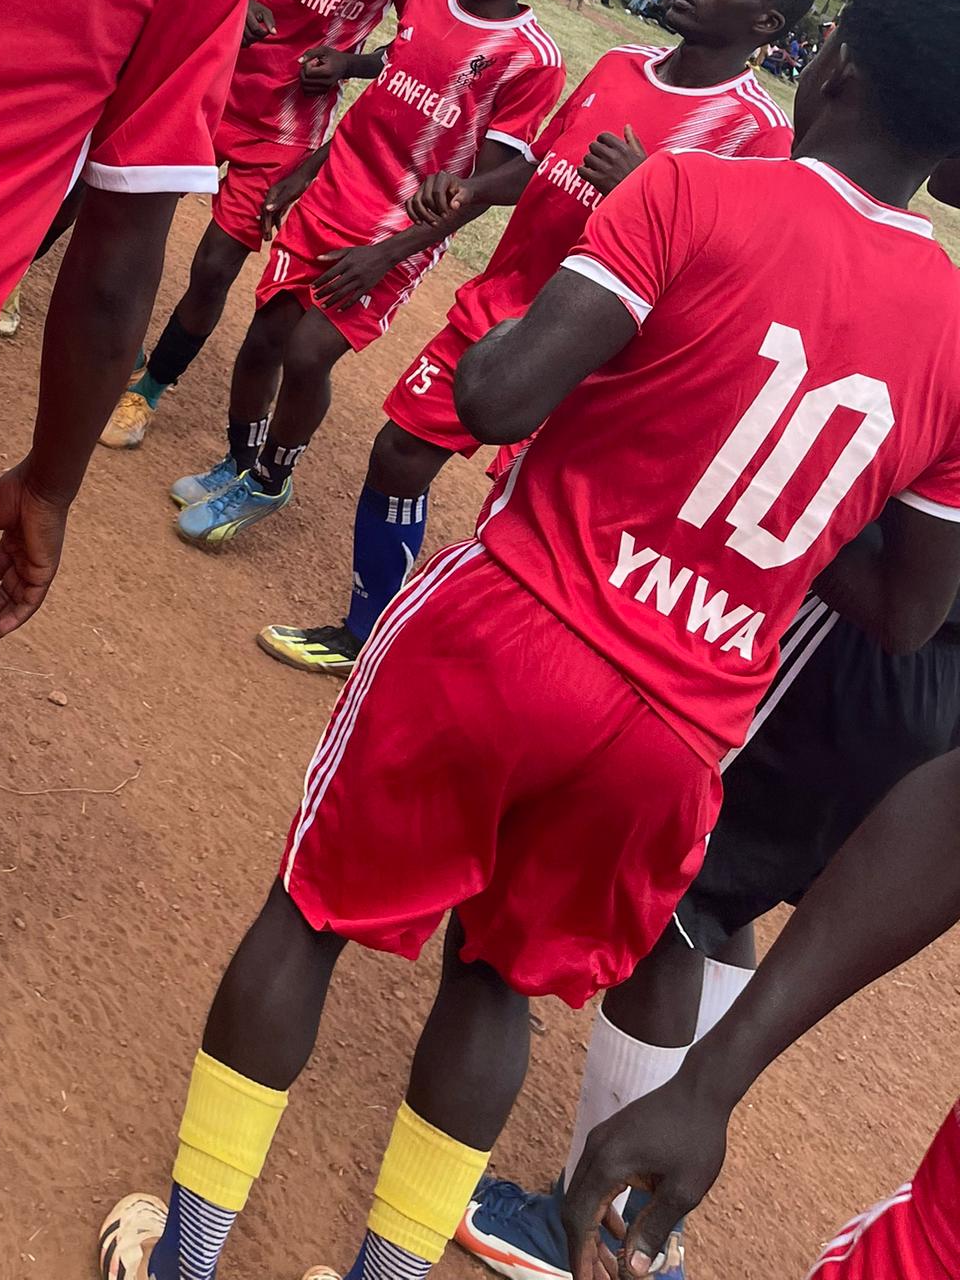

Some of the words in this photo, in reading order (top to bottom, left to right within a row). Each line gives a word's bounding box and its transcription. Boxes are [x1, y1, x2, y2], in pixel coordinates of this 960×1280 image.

[387, 70, 462, 129] ANFIELD
[273, 250, 290, 283] 11
[677, 321, 895, 570] 10
[608, 531, 766, 661] YNWA
